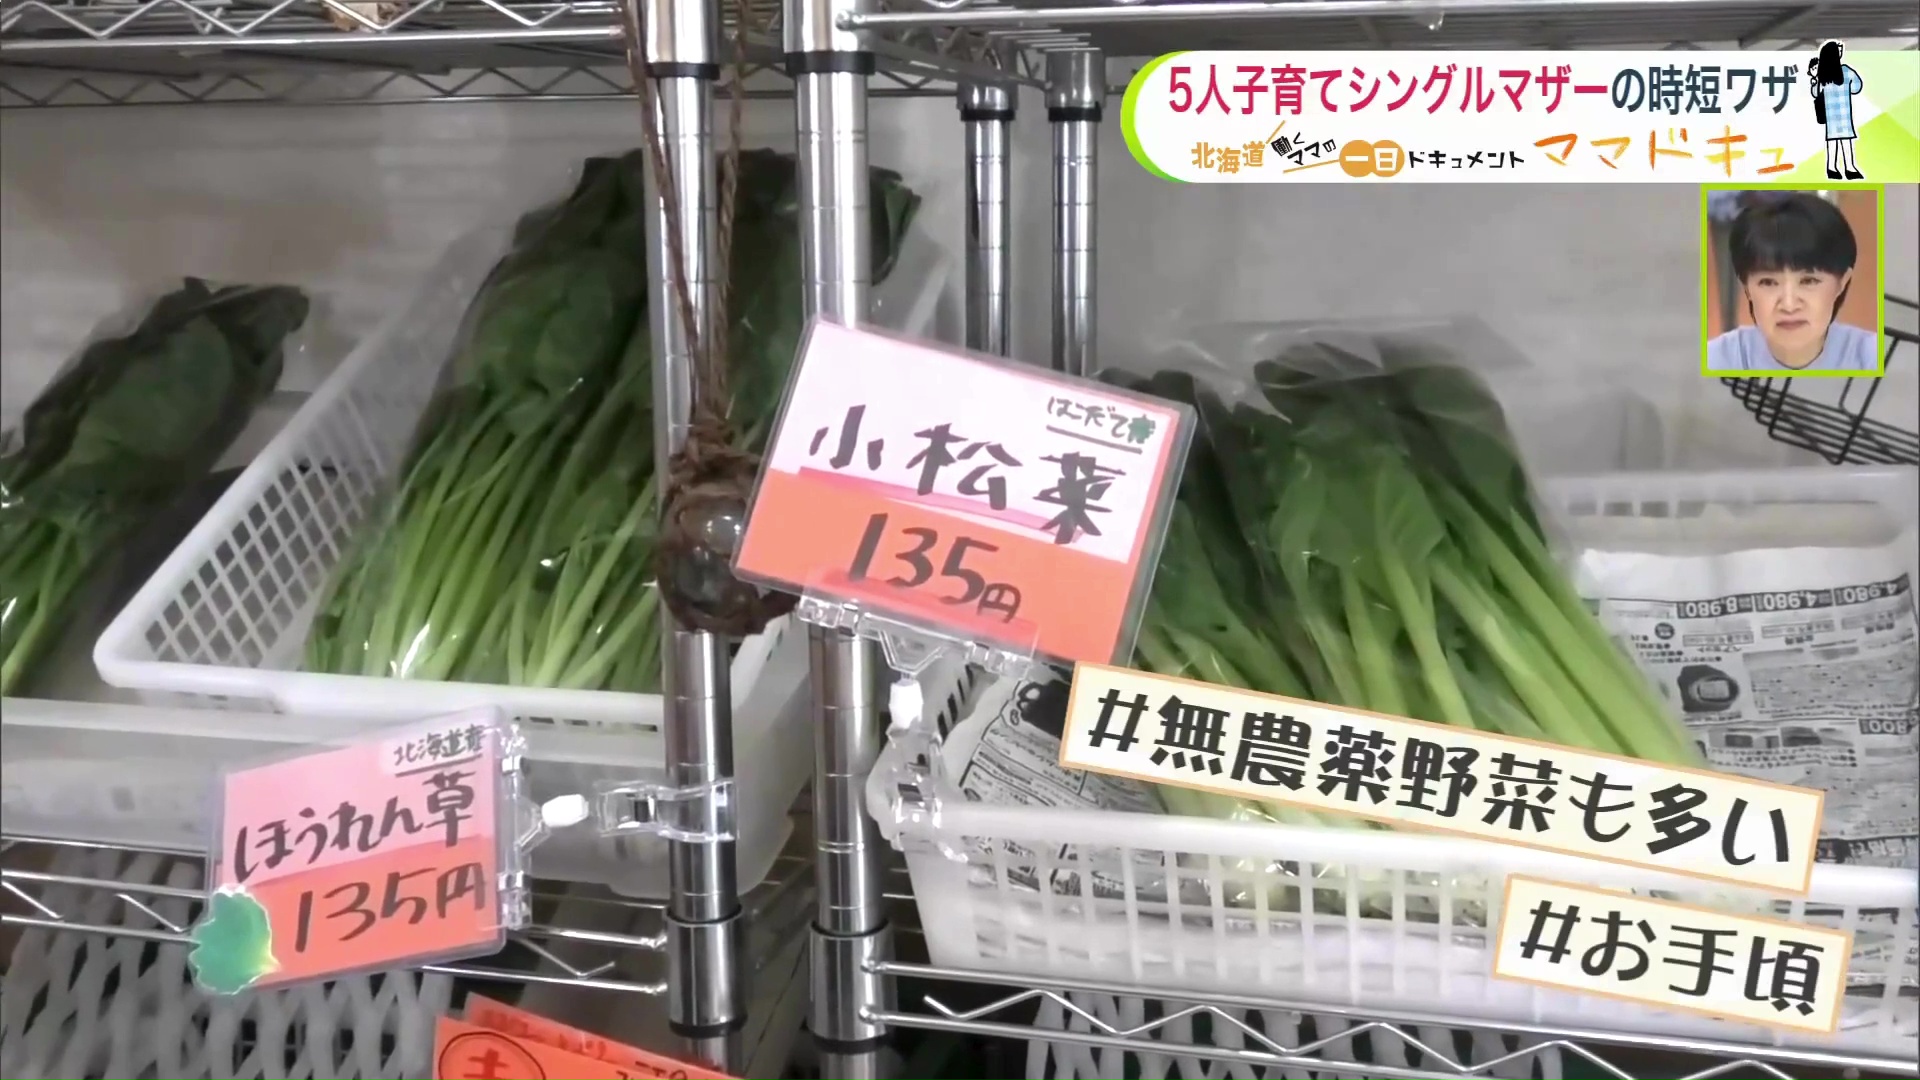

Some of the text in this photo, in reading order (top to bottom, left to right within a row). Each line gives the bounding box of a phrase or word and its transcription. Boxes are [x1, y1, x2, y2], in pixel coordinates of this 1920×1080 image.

[809, 404, 1126, 544] 小松菜
[847, 513, 1023, 624] 135円
[234, 769, 477, 884] ほうれん草
[295, 862, 488, 953] 135円
